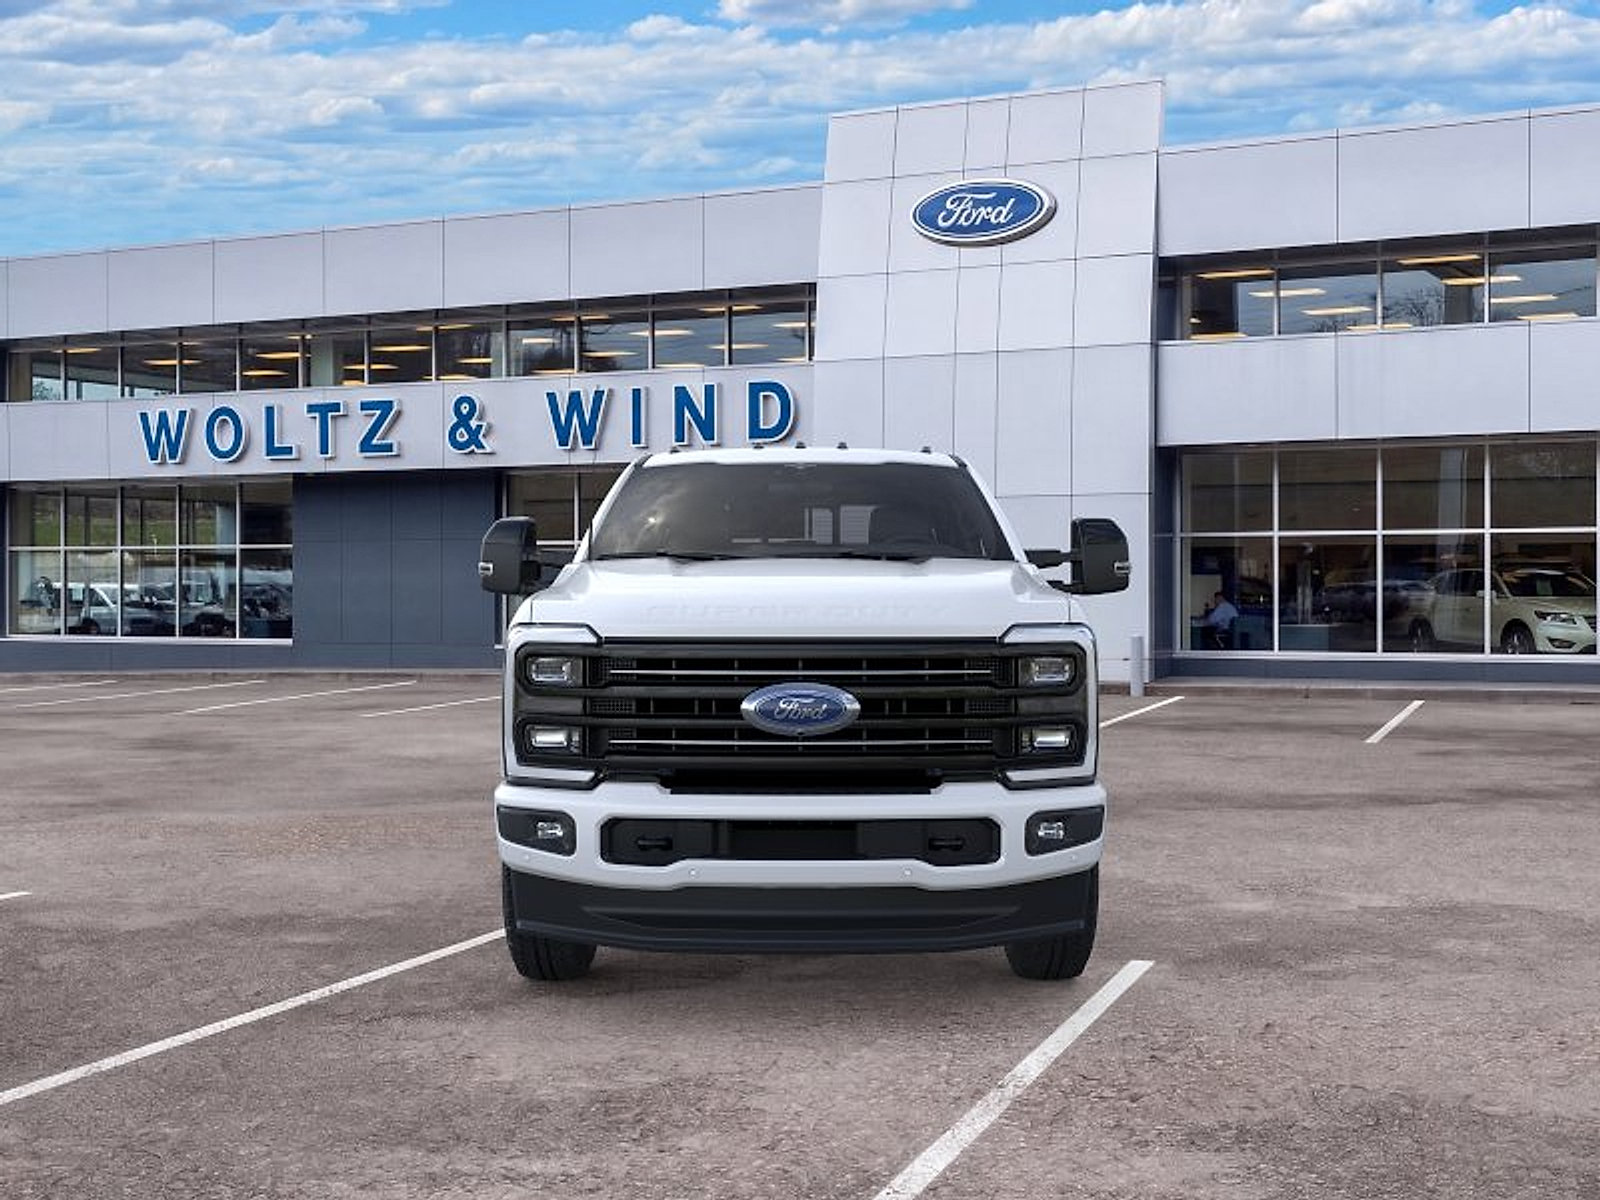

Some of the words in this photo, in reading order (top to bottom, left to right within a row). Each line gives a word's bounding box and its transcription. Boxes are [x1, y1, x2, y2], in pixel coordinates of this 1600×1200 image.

[937, 192, 1015, 228] Ford
[139, 398, 401, 464] WOLTZ
[447, 396, 494, 455] &
[546, 381, 796, 450] WIND
[774, 698, 828, 720] Ford
